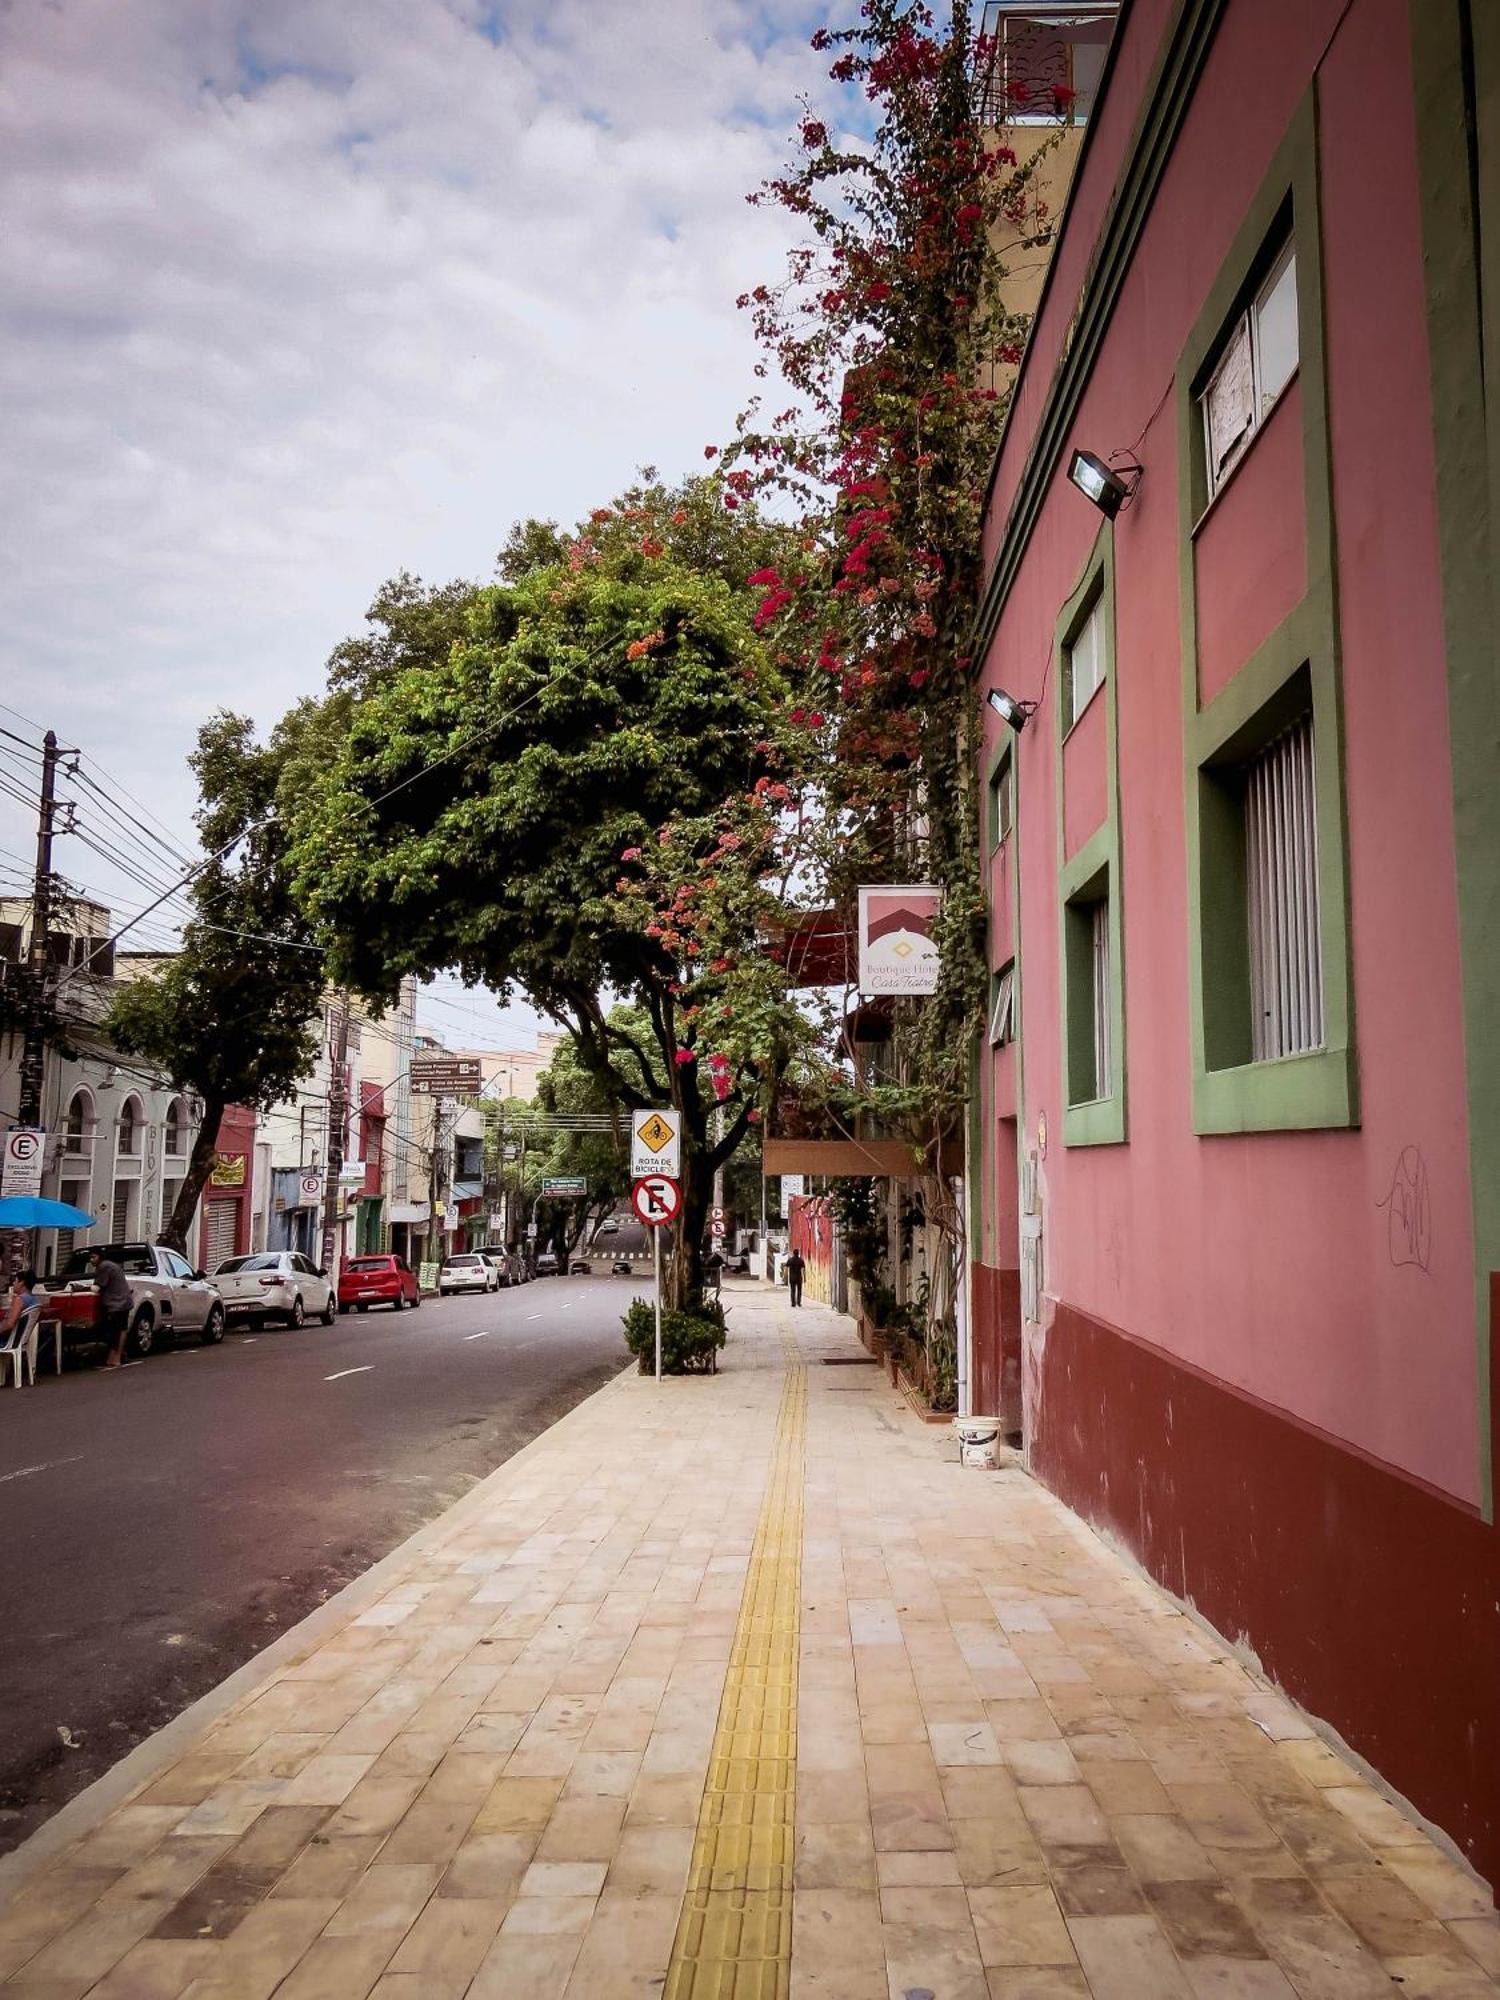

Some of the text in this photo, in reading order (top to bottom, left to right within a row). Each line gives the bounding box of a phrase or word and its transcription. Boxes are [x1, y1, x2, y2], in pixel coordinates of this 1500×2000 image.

[867, 964, 938, 976] Boutique Hote
[871, 976, 899, 988] Casa
[18, 1140, 30, 1155] E
[661, 1158, 672, 1166] DE
[307, 1181, 314, 1190] E
